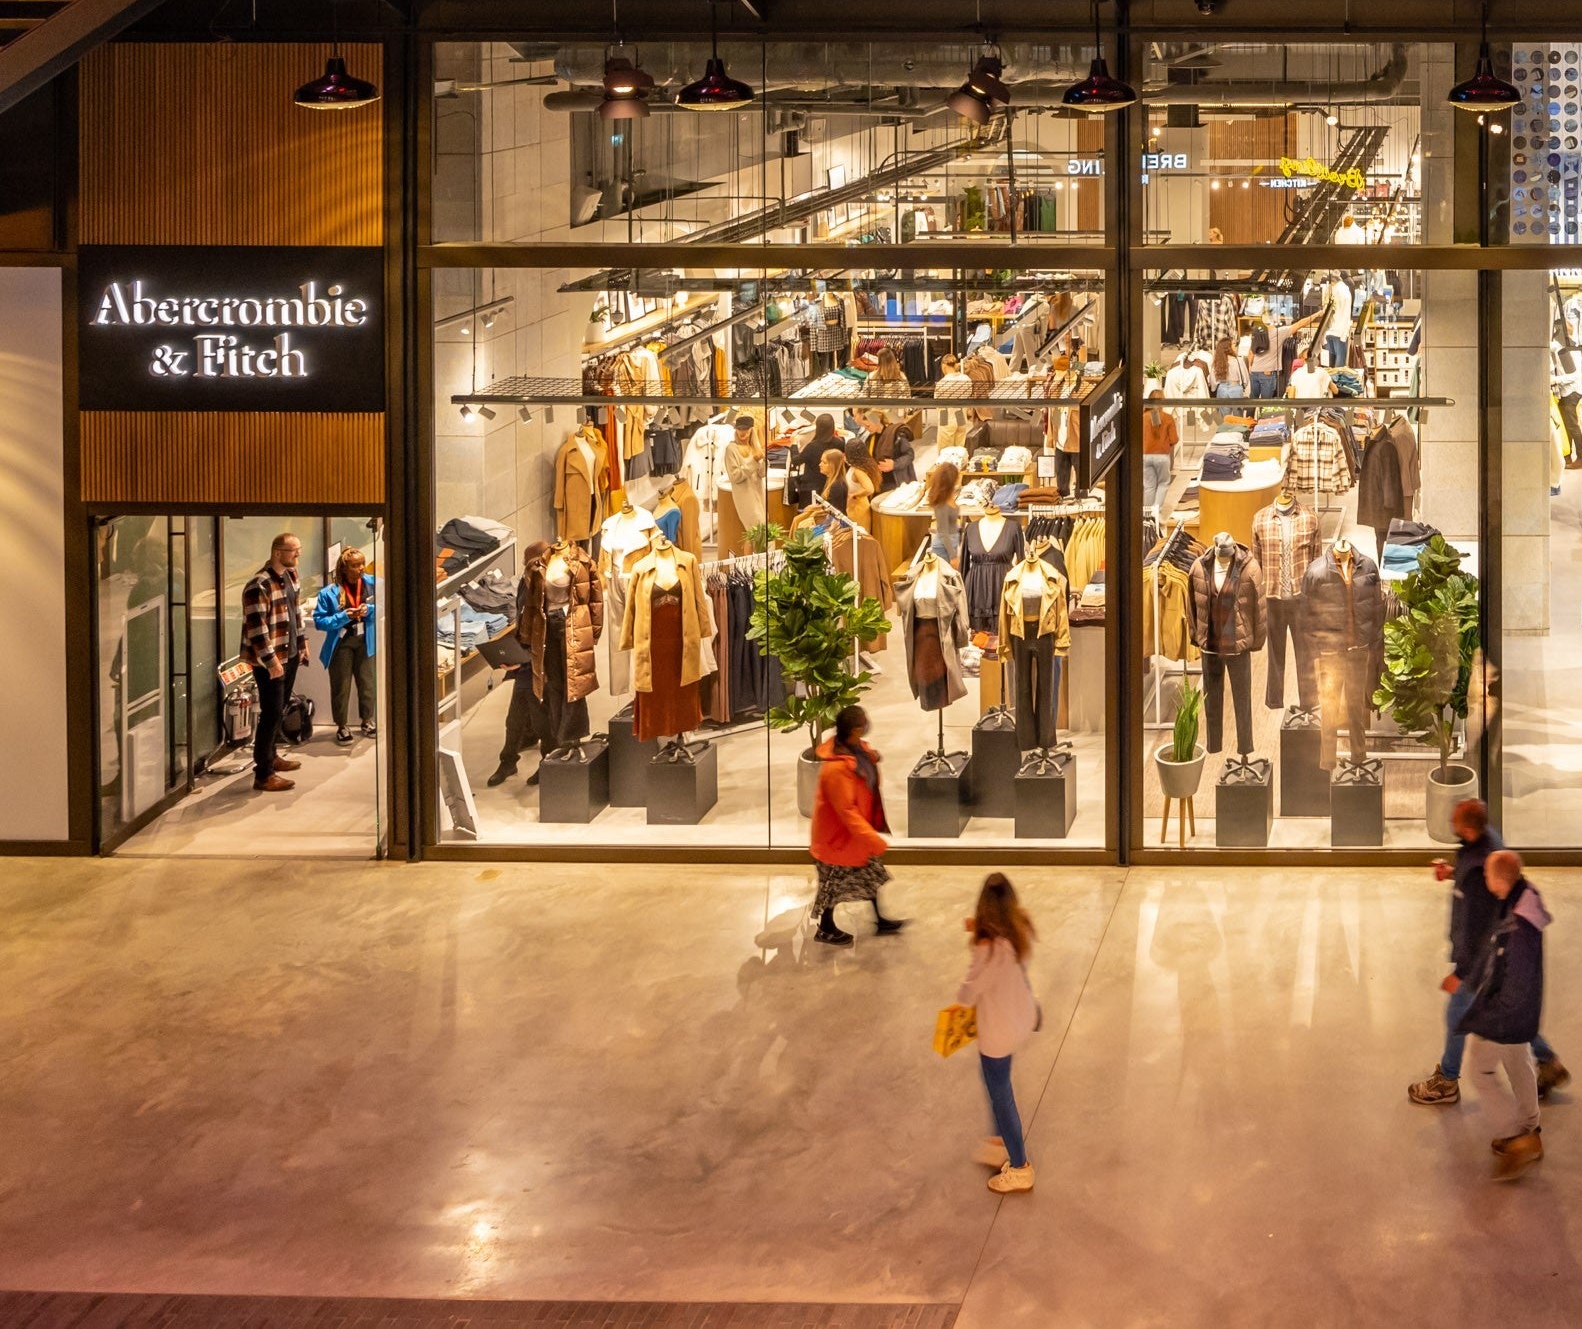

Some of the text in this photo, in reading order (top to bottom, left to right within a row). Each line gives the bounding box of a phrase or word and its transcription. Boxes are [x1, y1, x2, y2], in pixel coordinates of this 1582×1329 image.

[89, 280, 368, 328] Abercrombie
[149, 333, 308, 379] & Fitch
